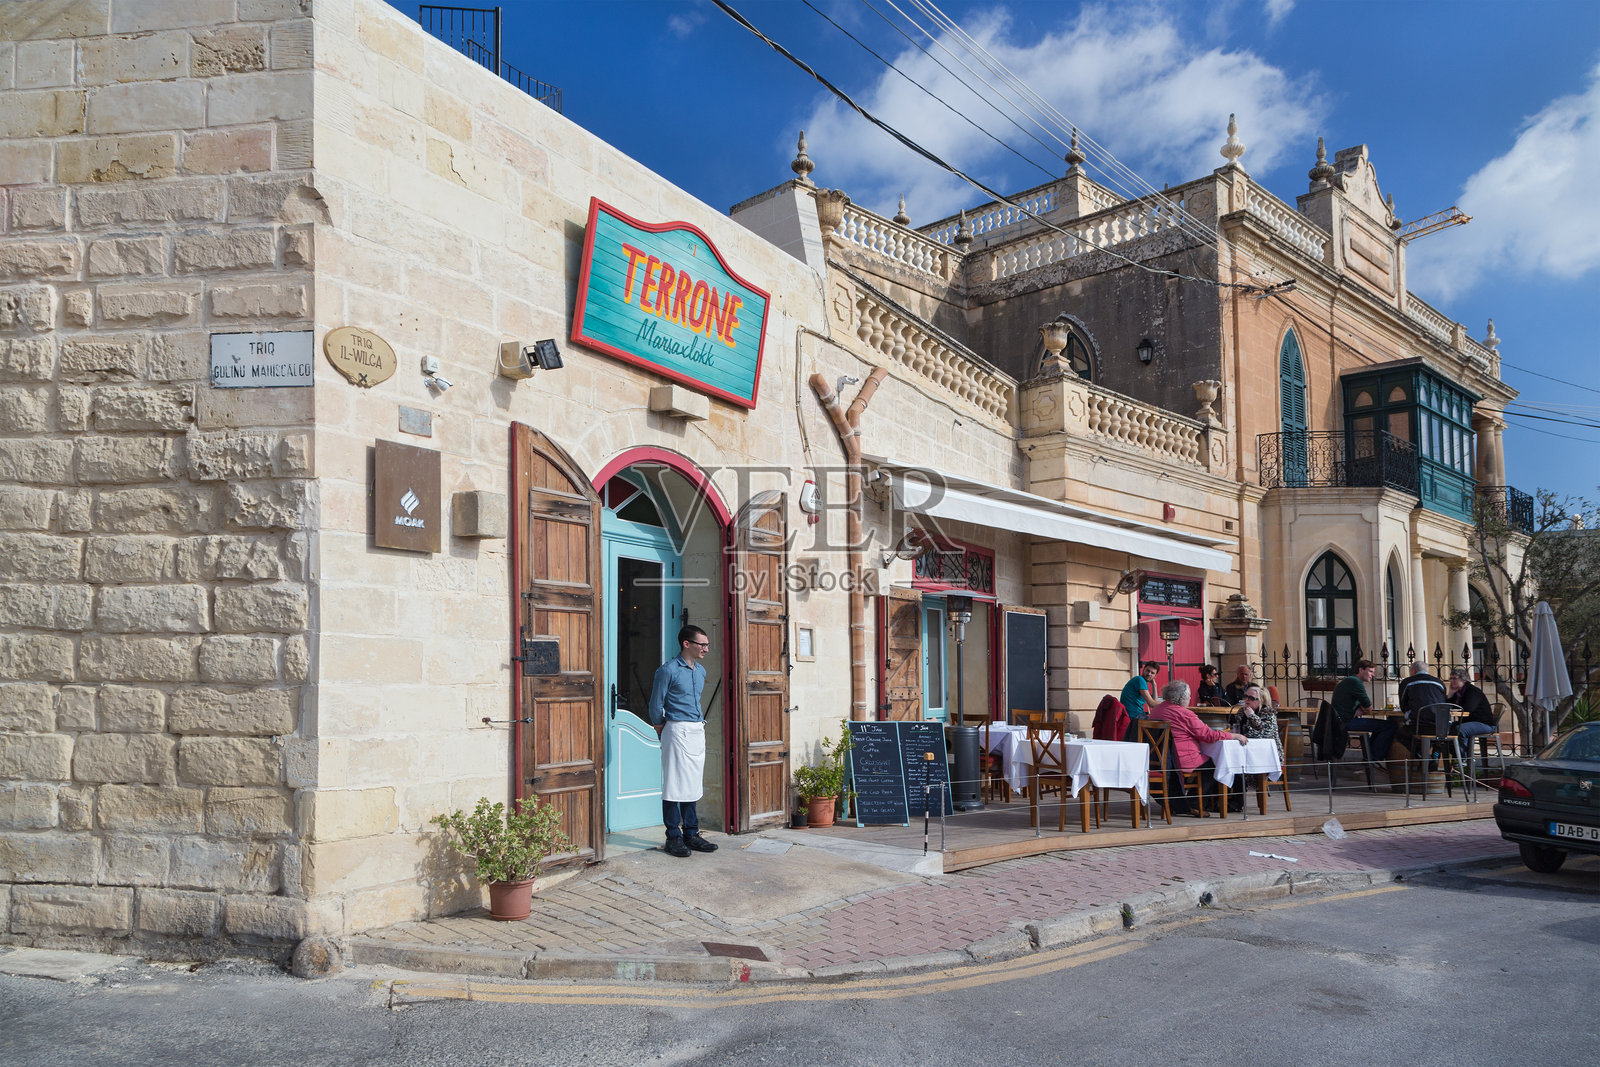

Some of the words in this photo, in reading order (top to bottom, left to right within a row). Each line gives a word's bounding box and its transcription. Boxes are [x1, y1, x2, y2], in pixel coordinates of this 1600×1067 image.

[622, 242, 743, 348] TERRONE
[249, 342, 275, 355] TRIQ
[351, 334, 372, 349] TRIQ
[635, 318, 715, 366] Marsaxlokk
[251, 363, 311, 377] MANISCALCO
[394, 515, 425, 529] MOAK
